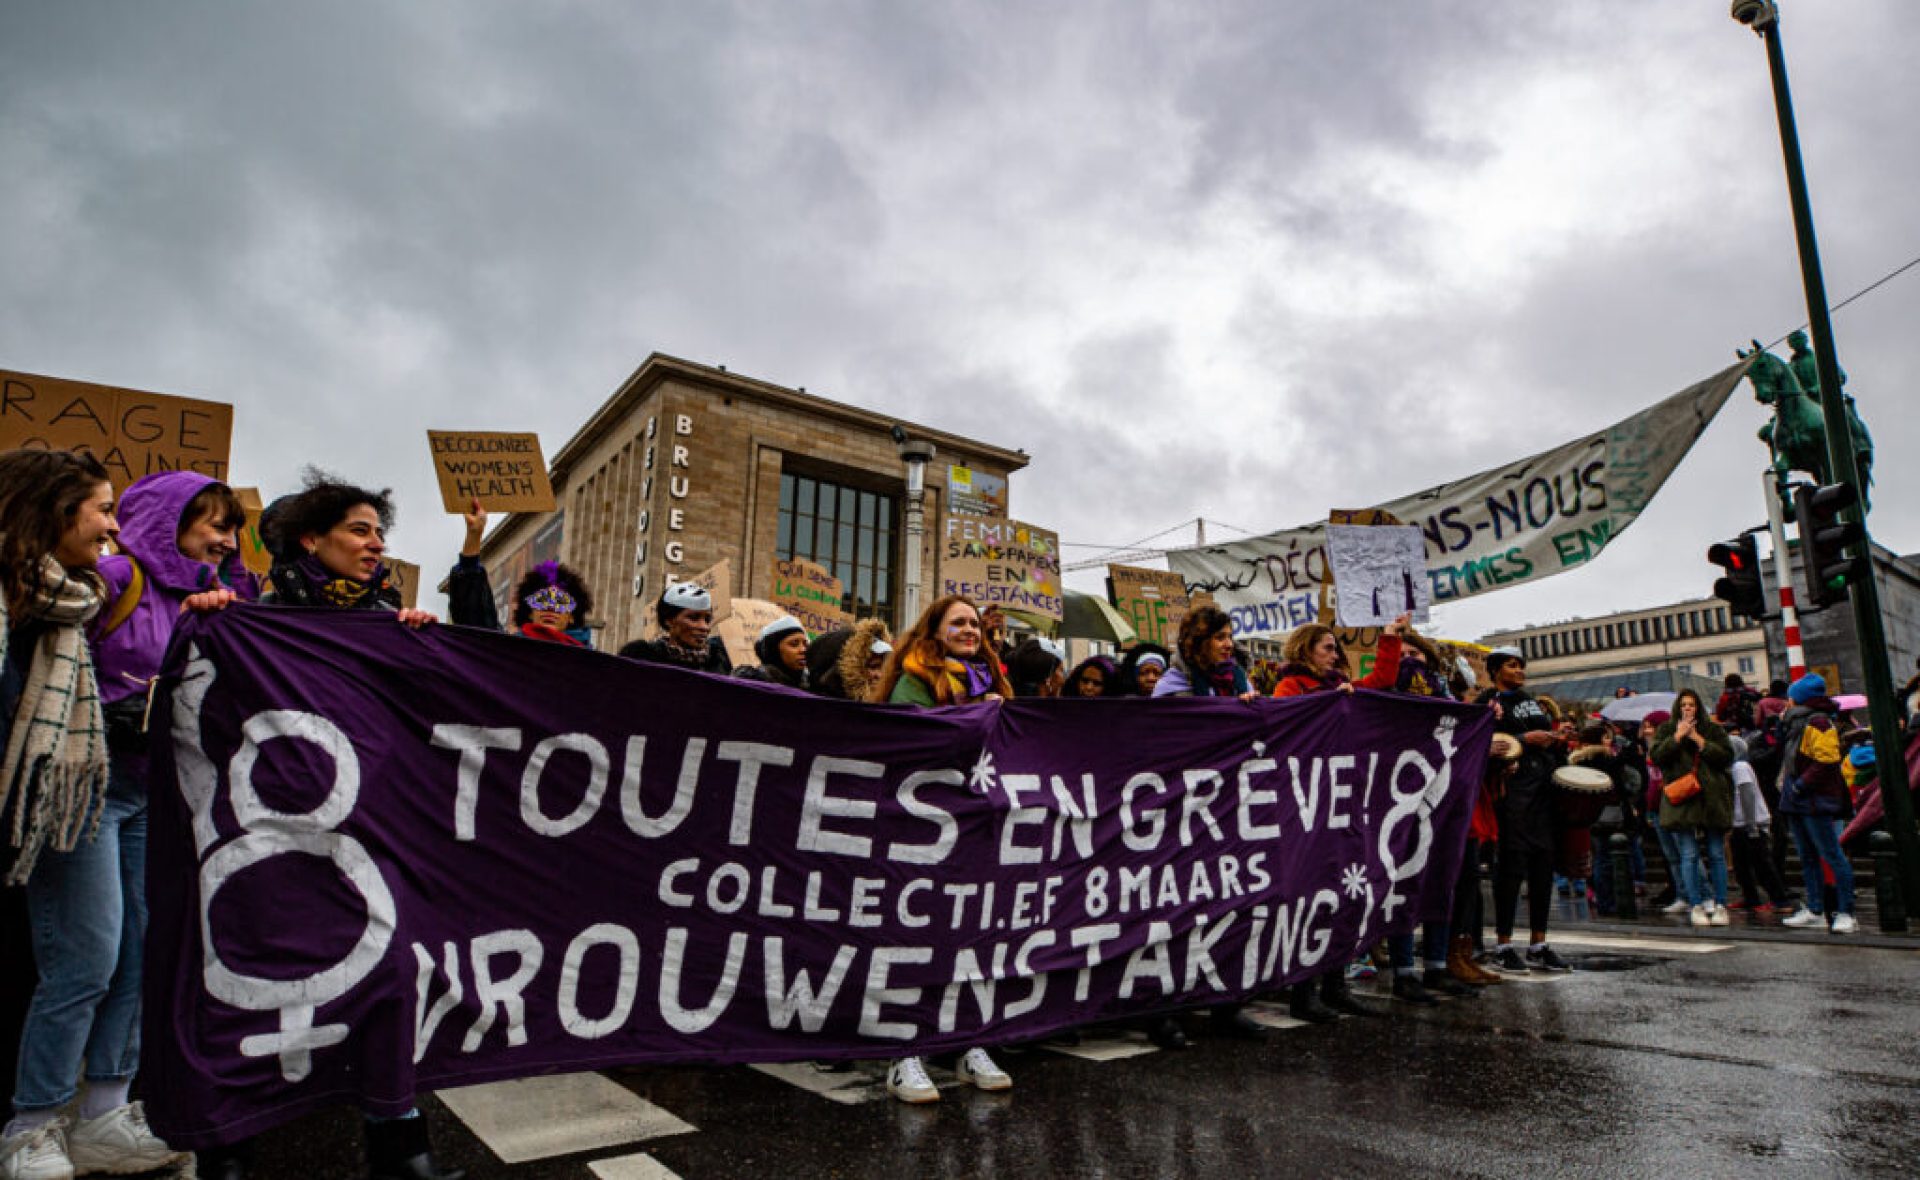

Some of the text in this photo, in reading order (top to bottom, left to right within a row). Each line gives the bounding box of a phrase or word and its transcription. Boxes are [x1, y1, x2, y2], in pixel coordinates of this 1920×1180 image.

[1, 379, 213, 451] RAGE
[444, 460, 533, 476] WOMEN'S
[457, 478, 535, 497] HEALTH
[987, 565, 1027, 583] EN
[1427, 547, 1534, 599] EMMES
[999, 773, 1098, 865] EN
[658, 851, 1272, 931] COLLECTI.E.F 8 MAARS
